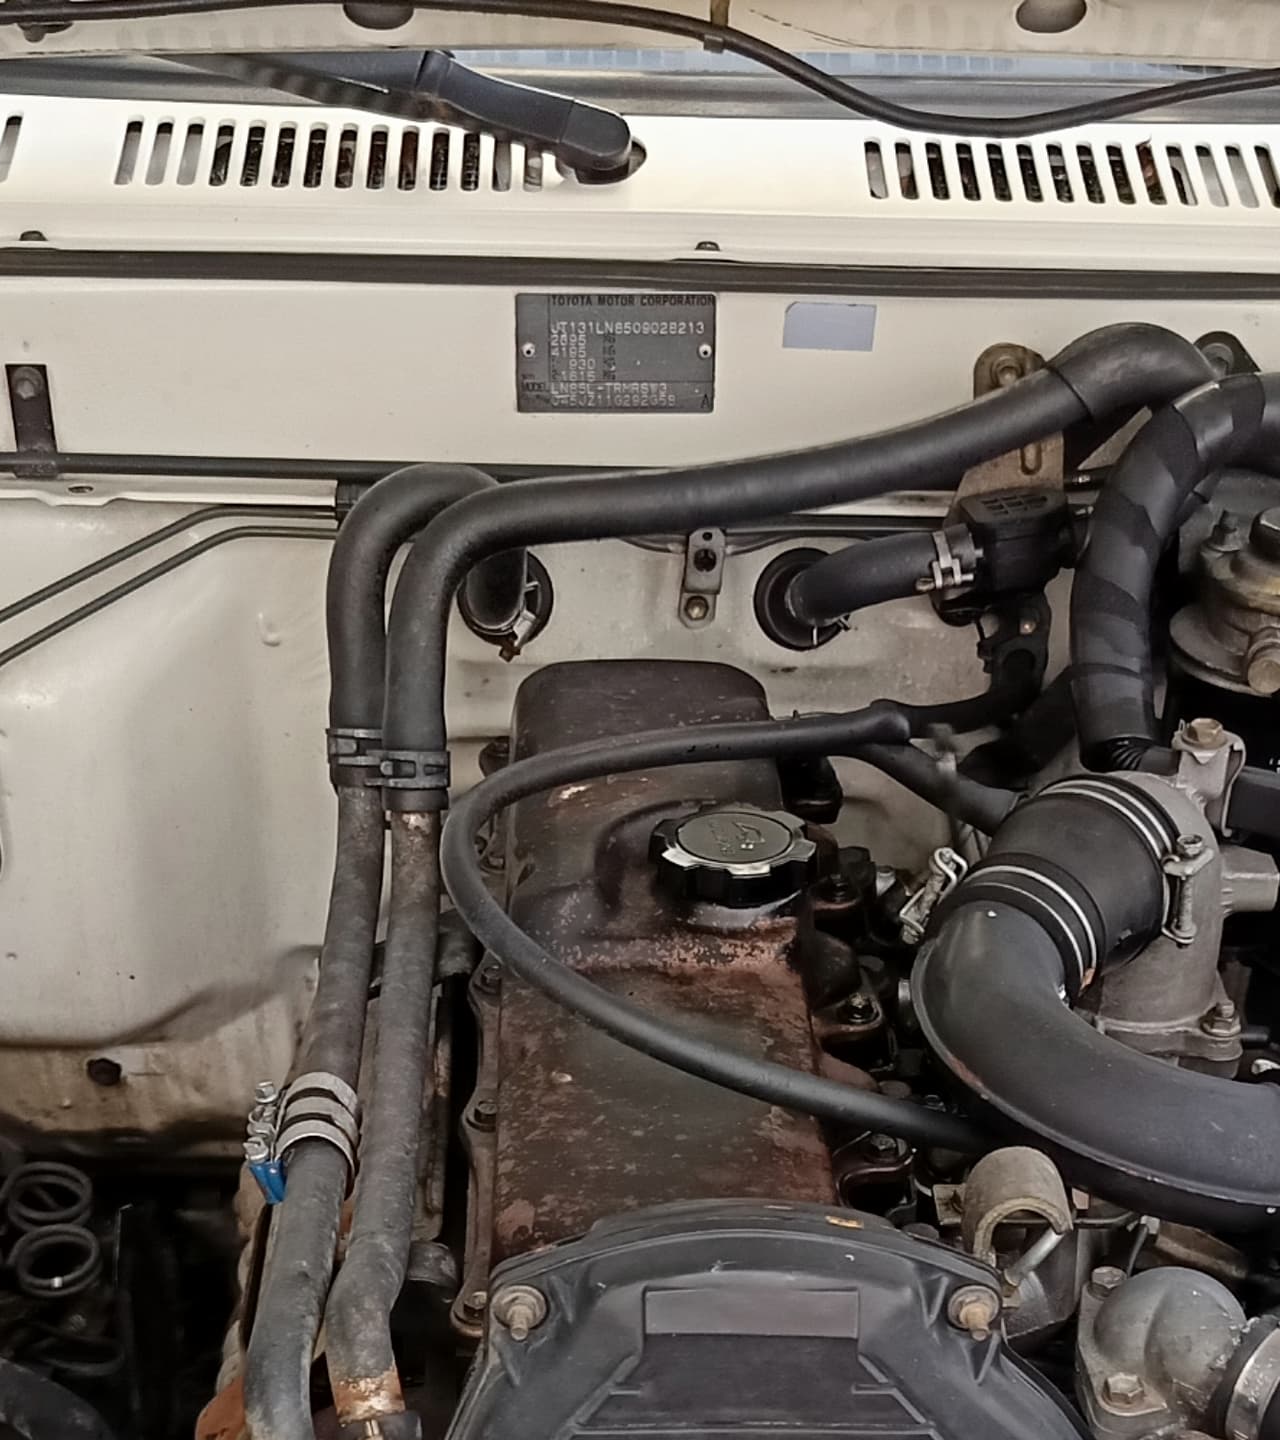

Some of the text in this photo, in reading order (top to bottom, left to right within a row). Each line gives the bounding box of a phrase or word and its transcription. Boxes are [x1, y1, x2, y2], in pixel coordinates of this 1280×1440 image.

[551, 295, 714, 307] TOYOTA MOTOR CORPORATION
